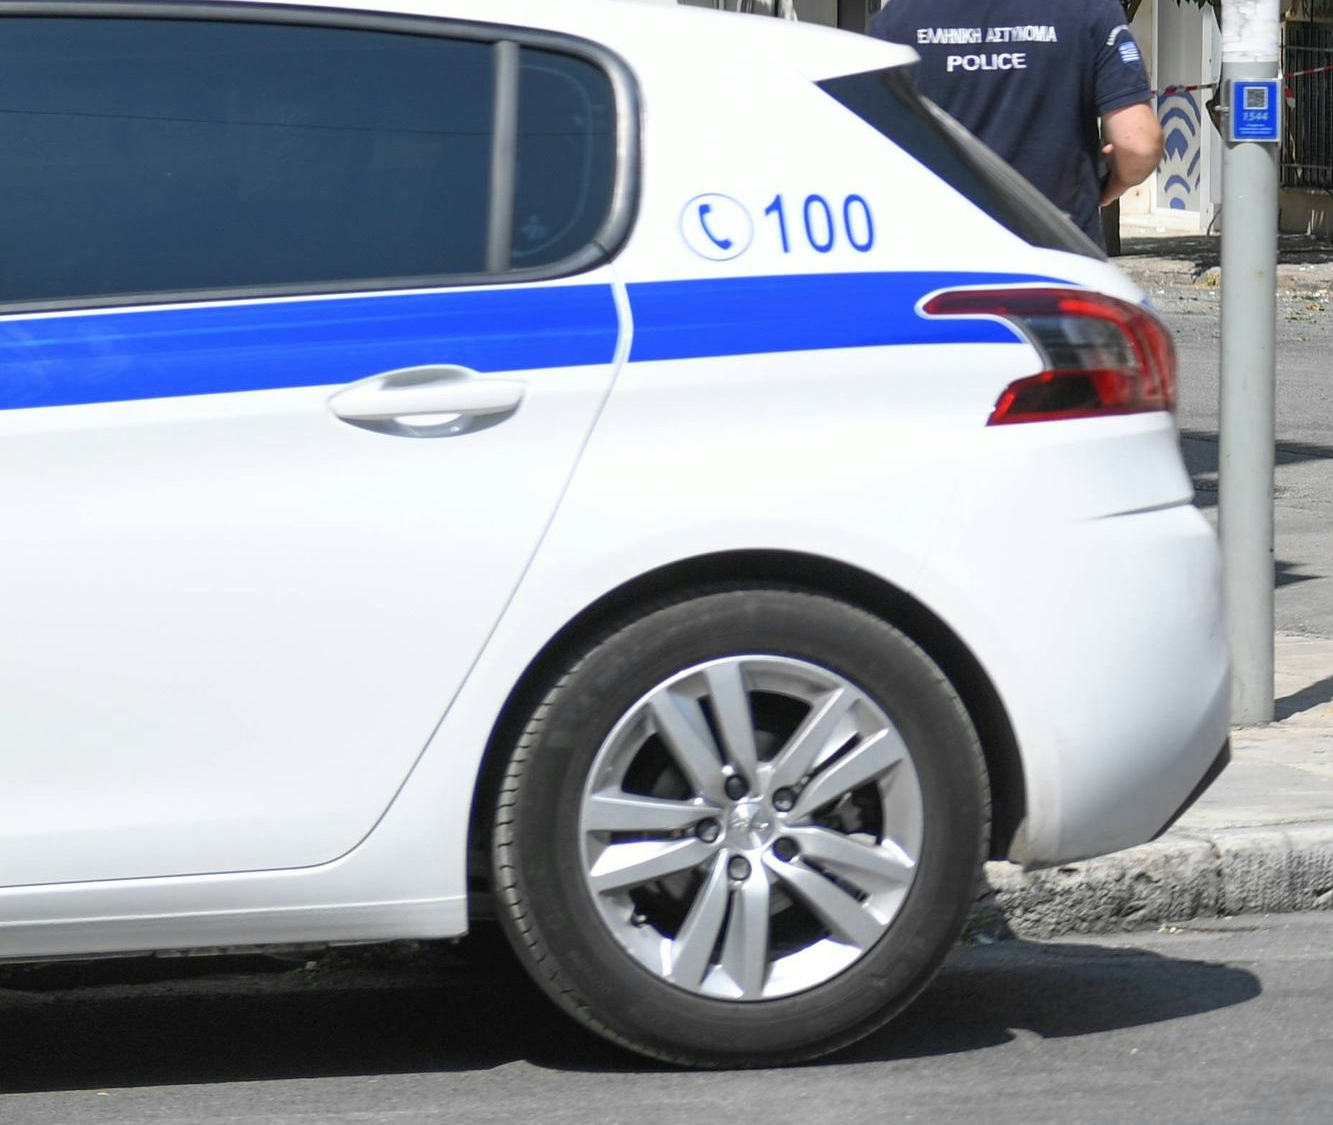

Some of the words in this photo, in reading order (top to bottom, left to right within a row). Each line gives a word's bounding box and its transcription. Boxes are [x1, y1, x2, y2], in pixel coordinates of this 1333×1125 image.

[917, 28, 982, 44] ΕΛΛΗΝΙΚΗ
[985, 25, 1057, 43] ΑΣΤΥΝΟΜΙΑ
[947, 53, 1027, 72] POLICE
[764, 194, 874, 253] 100
